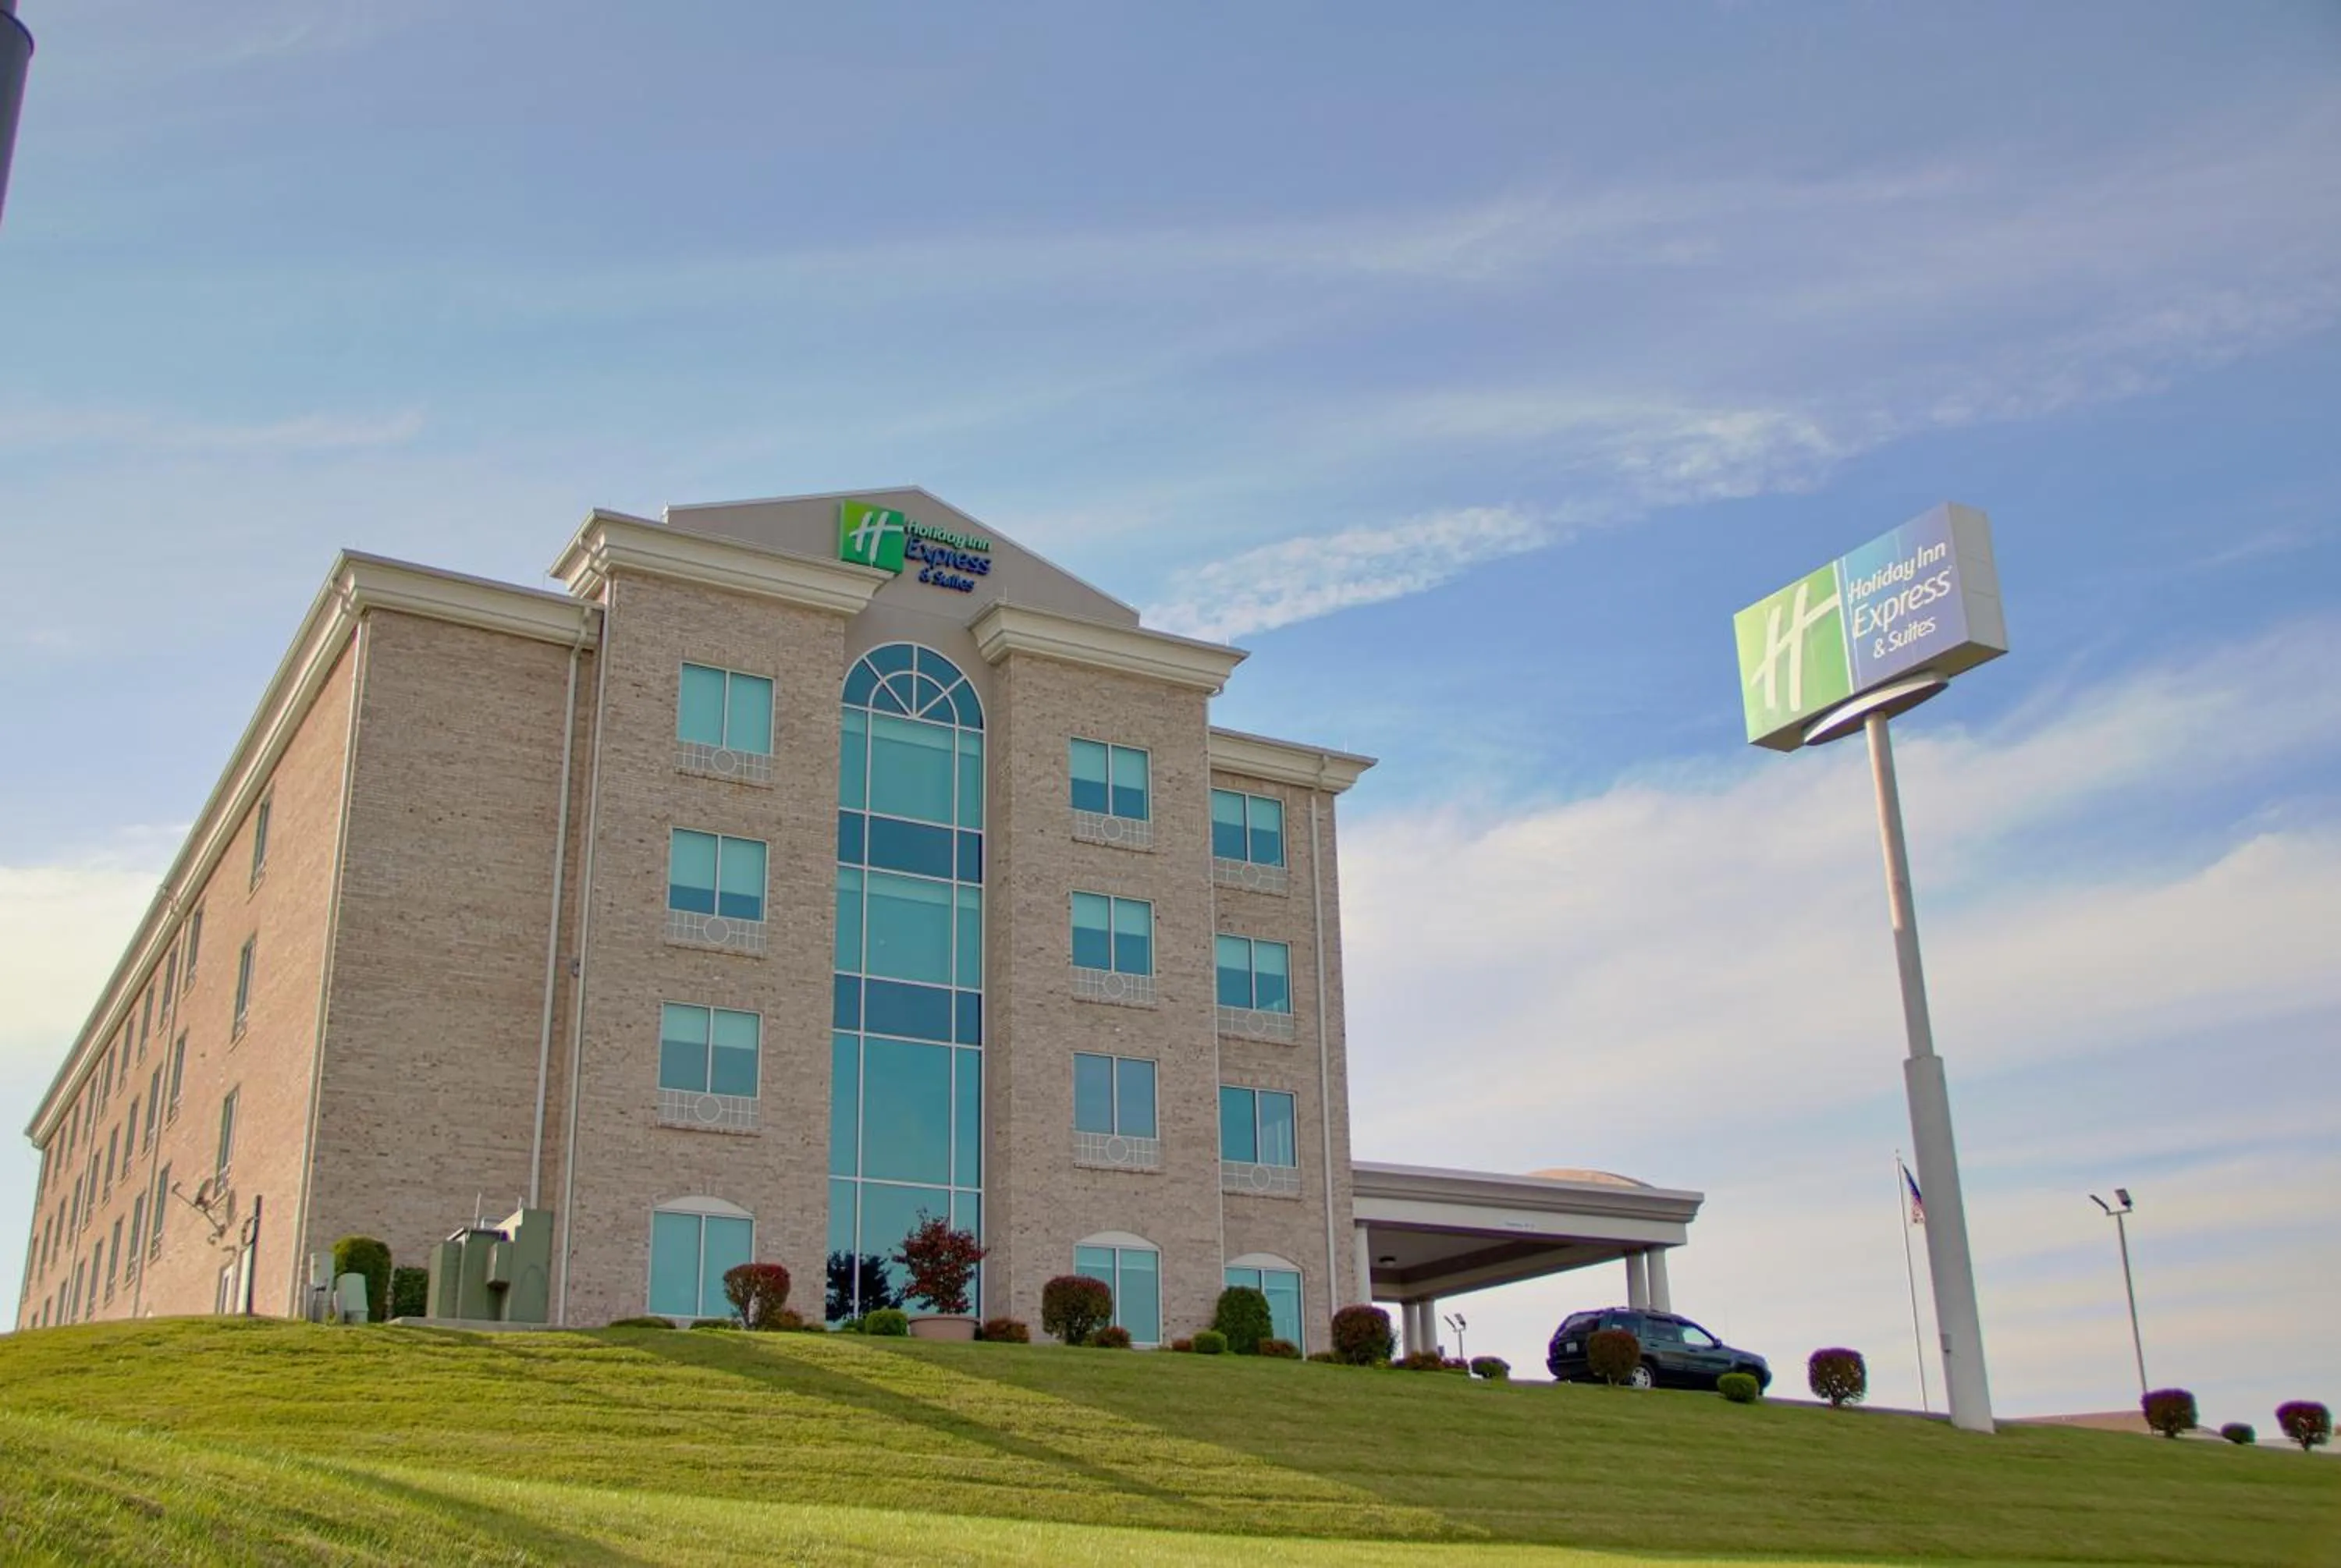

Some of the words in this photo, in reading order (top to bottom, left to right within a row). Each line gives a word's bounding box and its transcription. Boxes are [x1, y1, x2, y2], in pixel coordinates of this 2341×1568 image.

[904, 536, 992, 576] Express
[905, 519, 965, 549] Holiday
[968, 535, 990, 552] Inn
[918, 567, 929, 584] &
[932, 570, 975, 593] Suites
[1847, 557, 1915, 605] Holiday
[1917, 541, 1946, 569] Inn
[1853, 569, 1951, 639] Express
[1873, 637, 1885, 658] &
[1888, 616, 1936, 652] Suites
